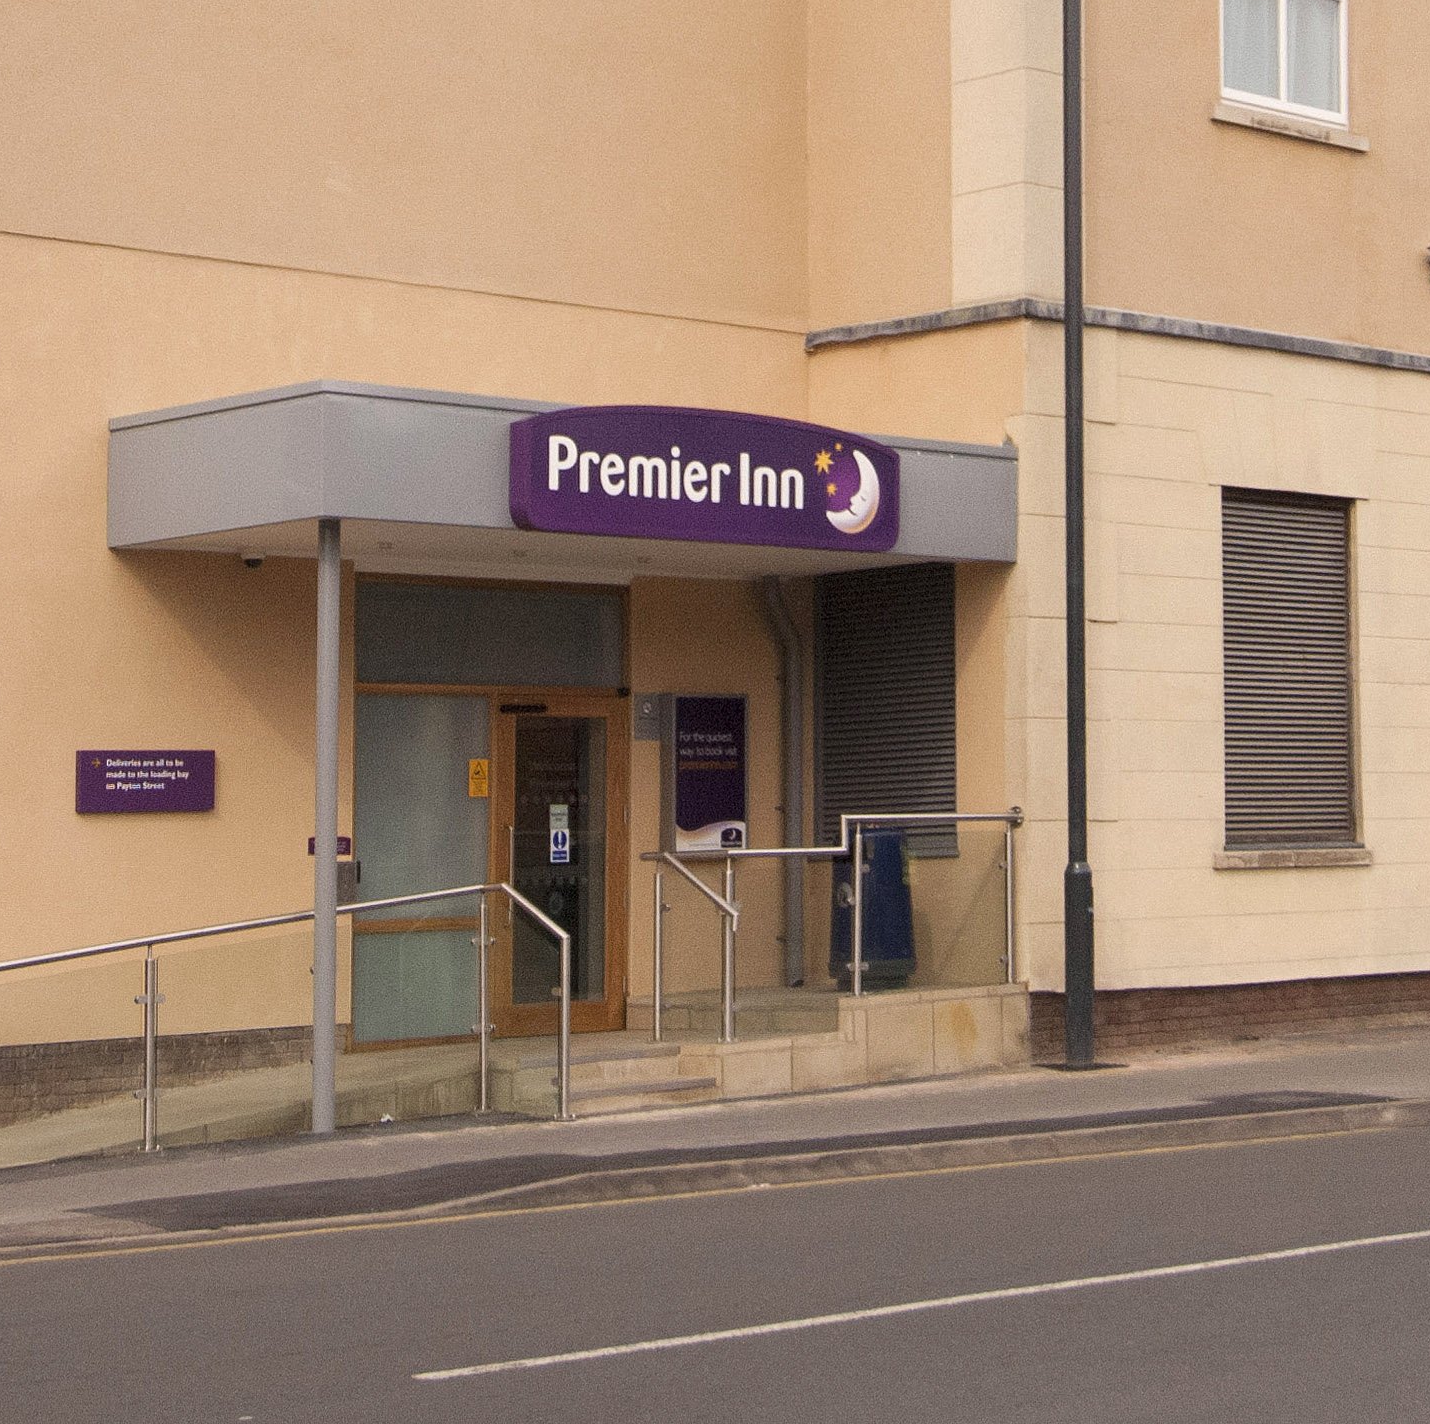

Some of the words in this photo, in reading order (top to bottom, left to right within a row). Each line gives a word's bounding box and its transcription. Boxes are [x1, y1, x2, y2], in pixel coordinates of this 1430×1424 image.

[548, 434, 731, 503] Premier
[739, 452, 804, 510] Inn
[106, 758, 141, 767] Deliveries
[156, 759, 164, 767] all
[166, 759, 173, 767] to
[175, 758, 184, 767] be
[106, 770, 126, 778] made
[137, 770, 149, 778] the
[150, 770, 176, 780] loading
[177, 770, 189, 780] bay
[142, 781, 165, 790] Street
